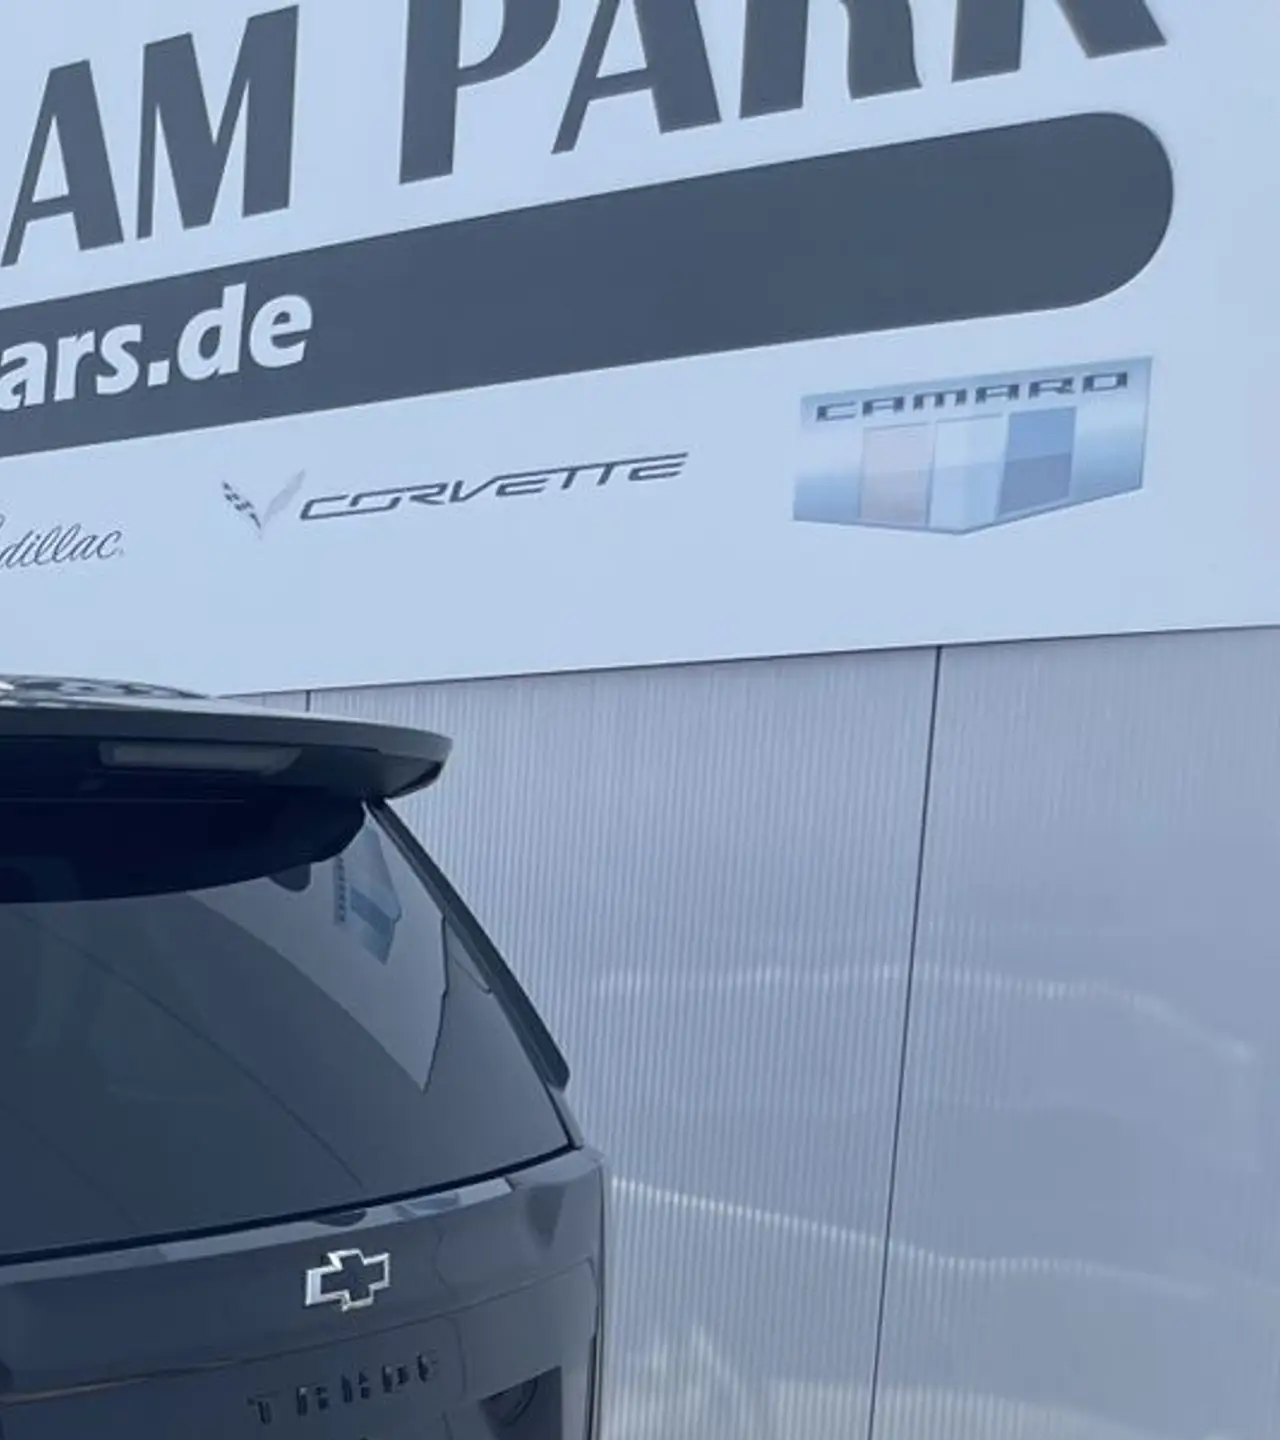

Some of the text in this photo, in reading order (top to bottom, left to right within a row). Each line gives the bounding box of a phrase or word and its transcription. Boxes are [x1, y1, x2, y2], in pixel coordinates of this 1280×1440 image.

[0, 4, 299, 267] AM
[399, 0, 1166, 184] PA
[816, 372, 1128, 421] CAMARO
[299, 452, 688, 520] CORVETTE
